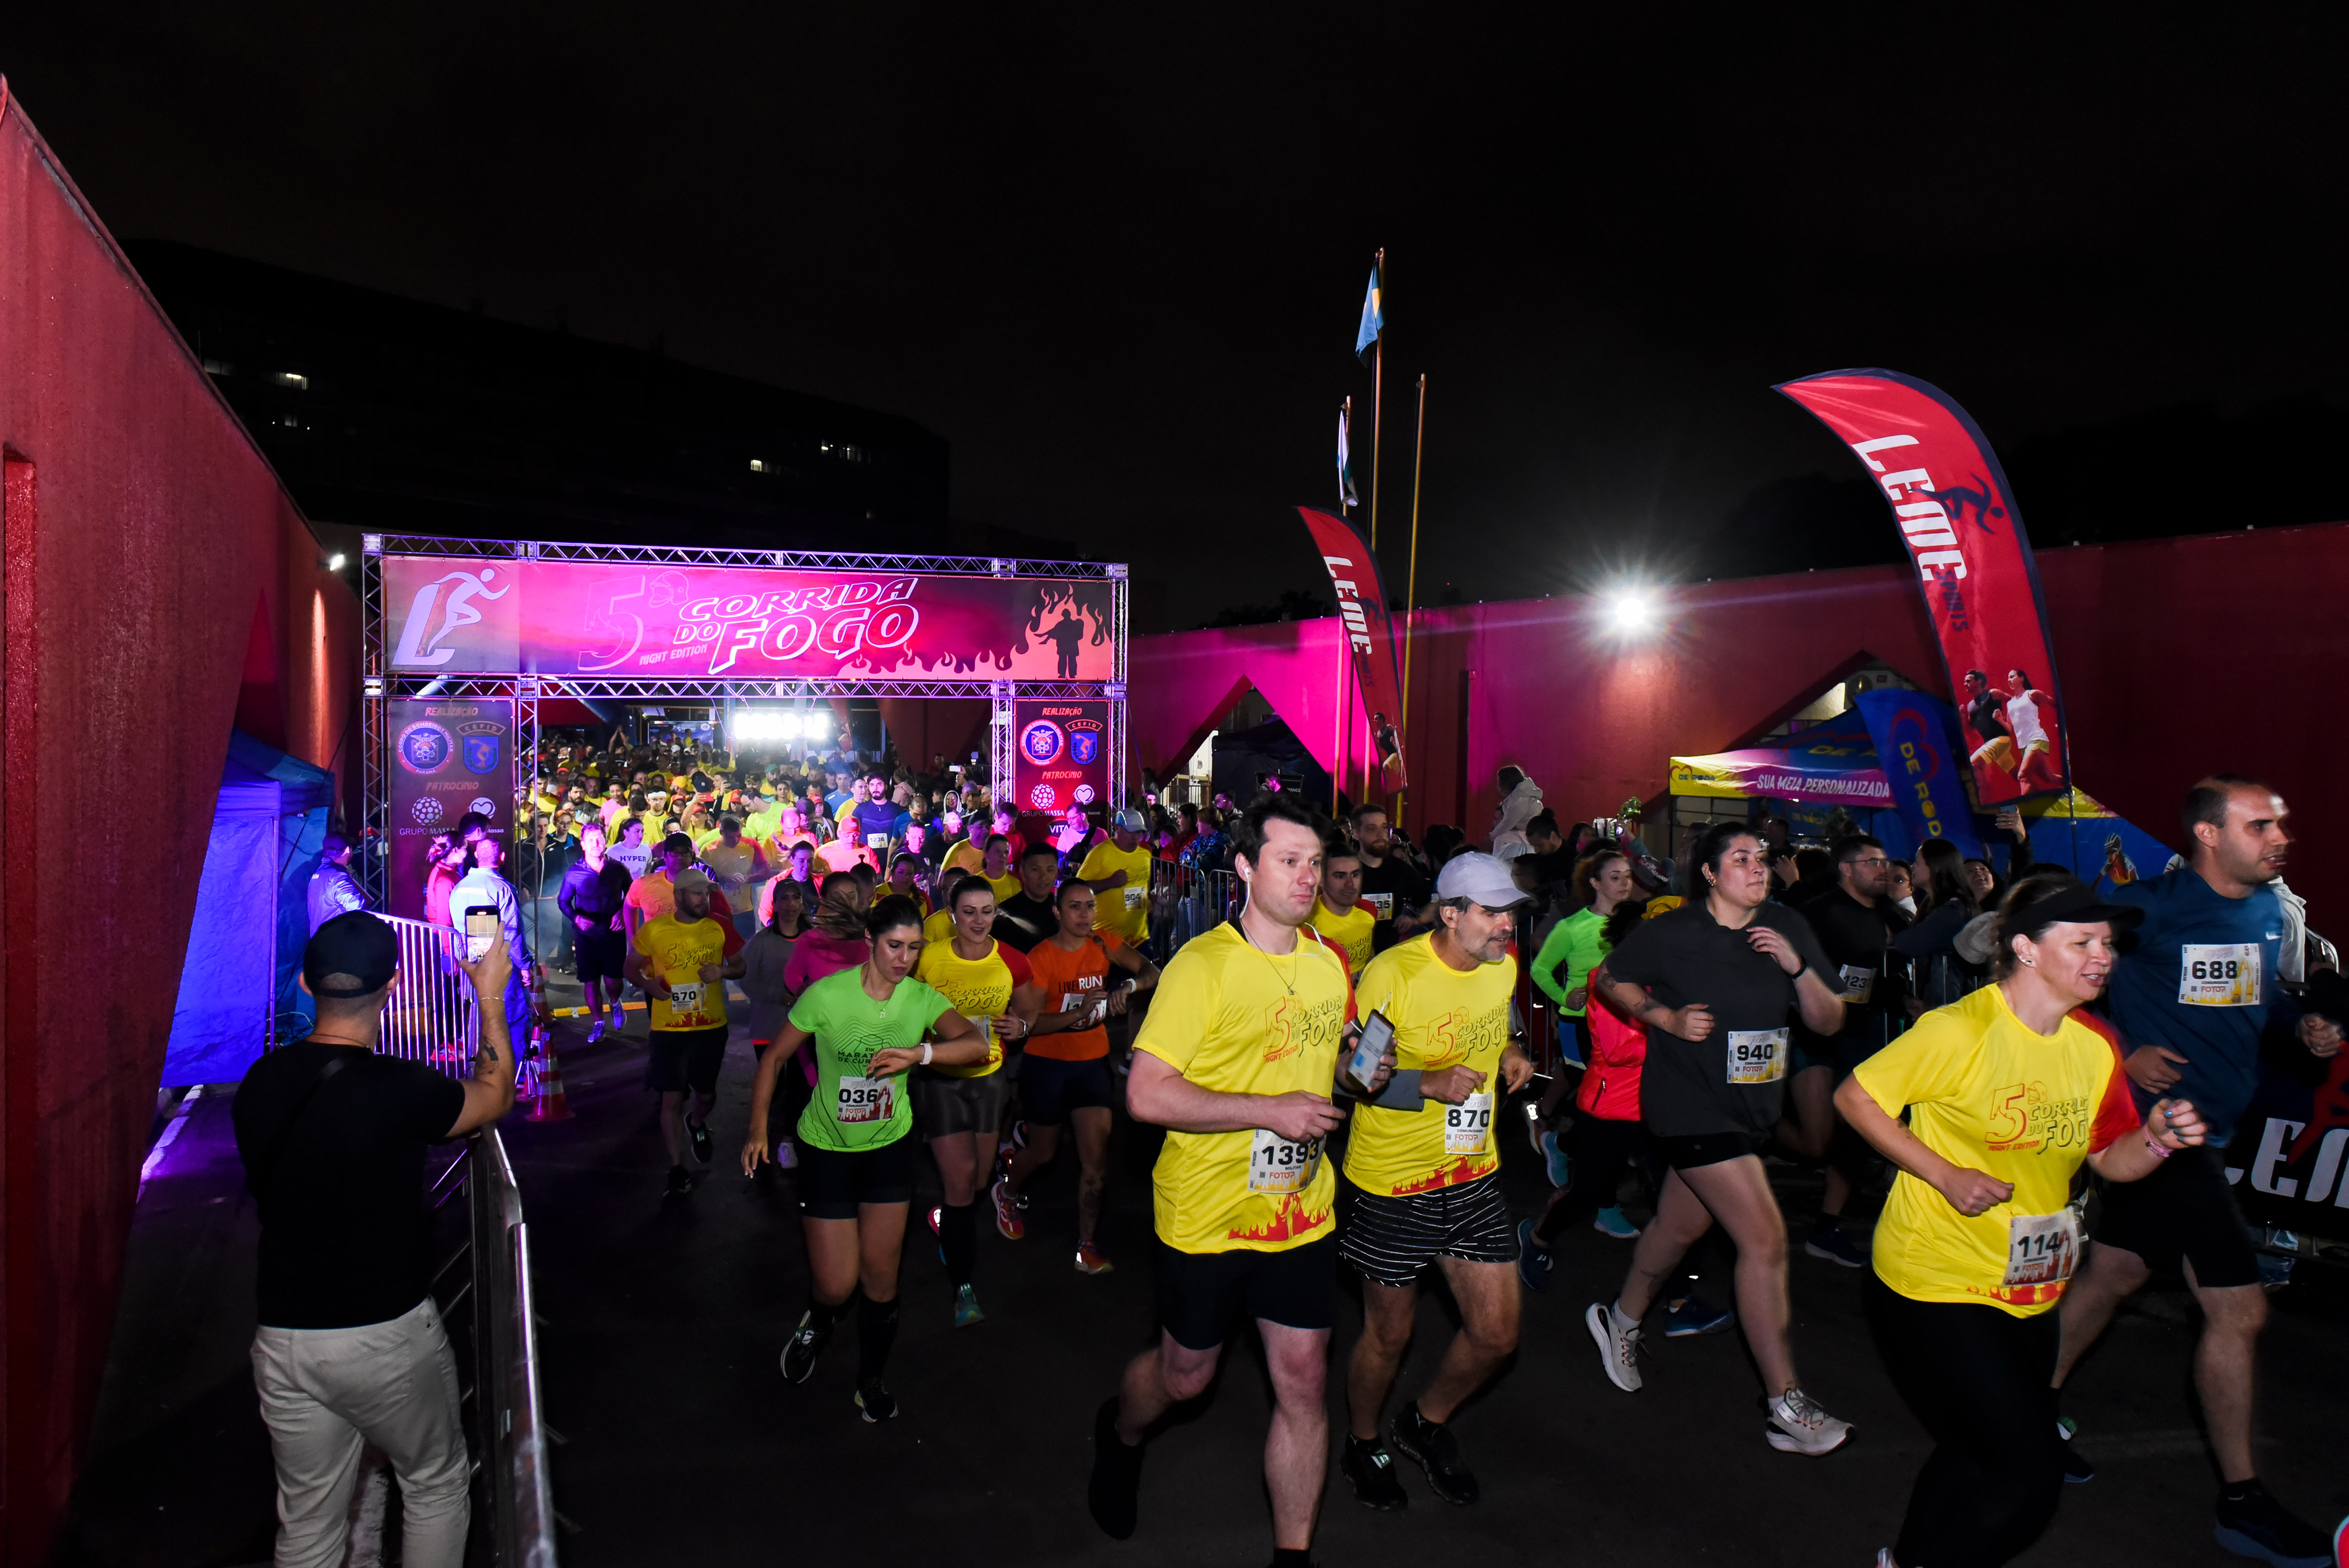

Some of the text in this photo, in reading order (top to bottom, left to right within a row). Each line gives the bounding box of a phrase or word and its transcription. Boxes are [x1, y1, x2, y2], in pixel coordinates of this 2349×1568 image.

[1851, 434, 1968, 581] LEME
[679, 577, 918, 622] CORRIDA
[1323, 555, 1372, 654] LEME
[673, 624, 721, 644] DO
[708, 603, 920, 676] FOGO
[639, 644, 707, 665] NIGHT EDITION
[1041, 707, 1083, 716] REALIZAÇÃO
[1041, 771, 1083, 780] PATROCÍNIO
[1757, 774, 1890, 798] SUA MEIA PERSONALIZADA
[399, 827, 428, 836] GRUPO
[1372, 900, 1390, 909] 35
[2192, 960, 2238, 980] 688
[947, 984, 1006, 998] CORRIDA
[1078, 975, 1103, 990] RUN
[672, 990, 697, 1002] 670
[955, 993, 1004, 1010] FOGO
[1290, 995, 1342, 1028] CORRIDA
[1454, 998, 1510, 1040] CORRIDA
[1298, 1010, 1345, 1058] FOGO
[1462, 1013, 1508, 1062] FOGO
[1737, 1043, 1774, 1061] 940
[838, 1088, 878, 1104] 036
[1447, 1109, 1490, 1128] 870
[2027, 1122, 2044, 1136] DO
[2036, 1117, 2090, 1155] FOG
[1262, 1140, 1320, 1165] 1393
[2012, 1140, 2041, 1151] EDITION
[1269, 1171, 1295, 1179] FOTOP
[2017, 1231, 2060, 1258] 114
